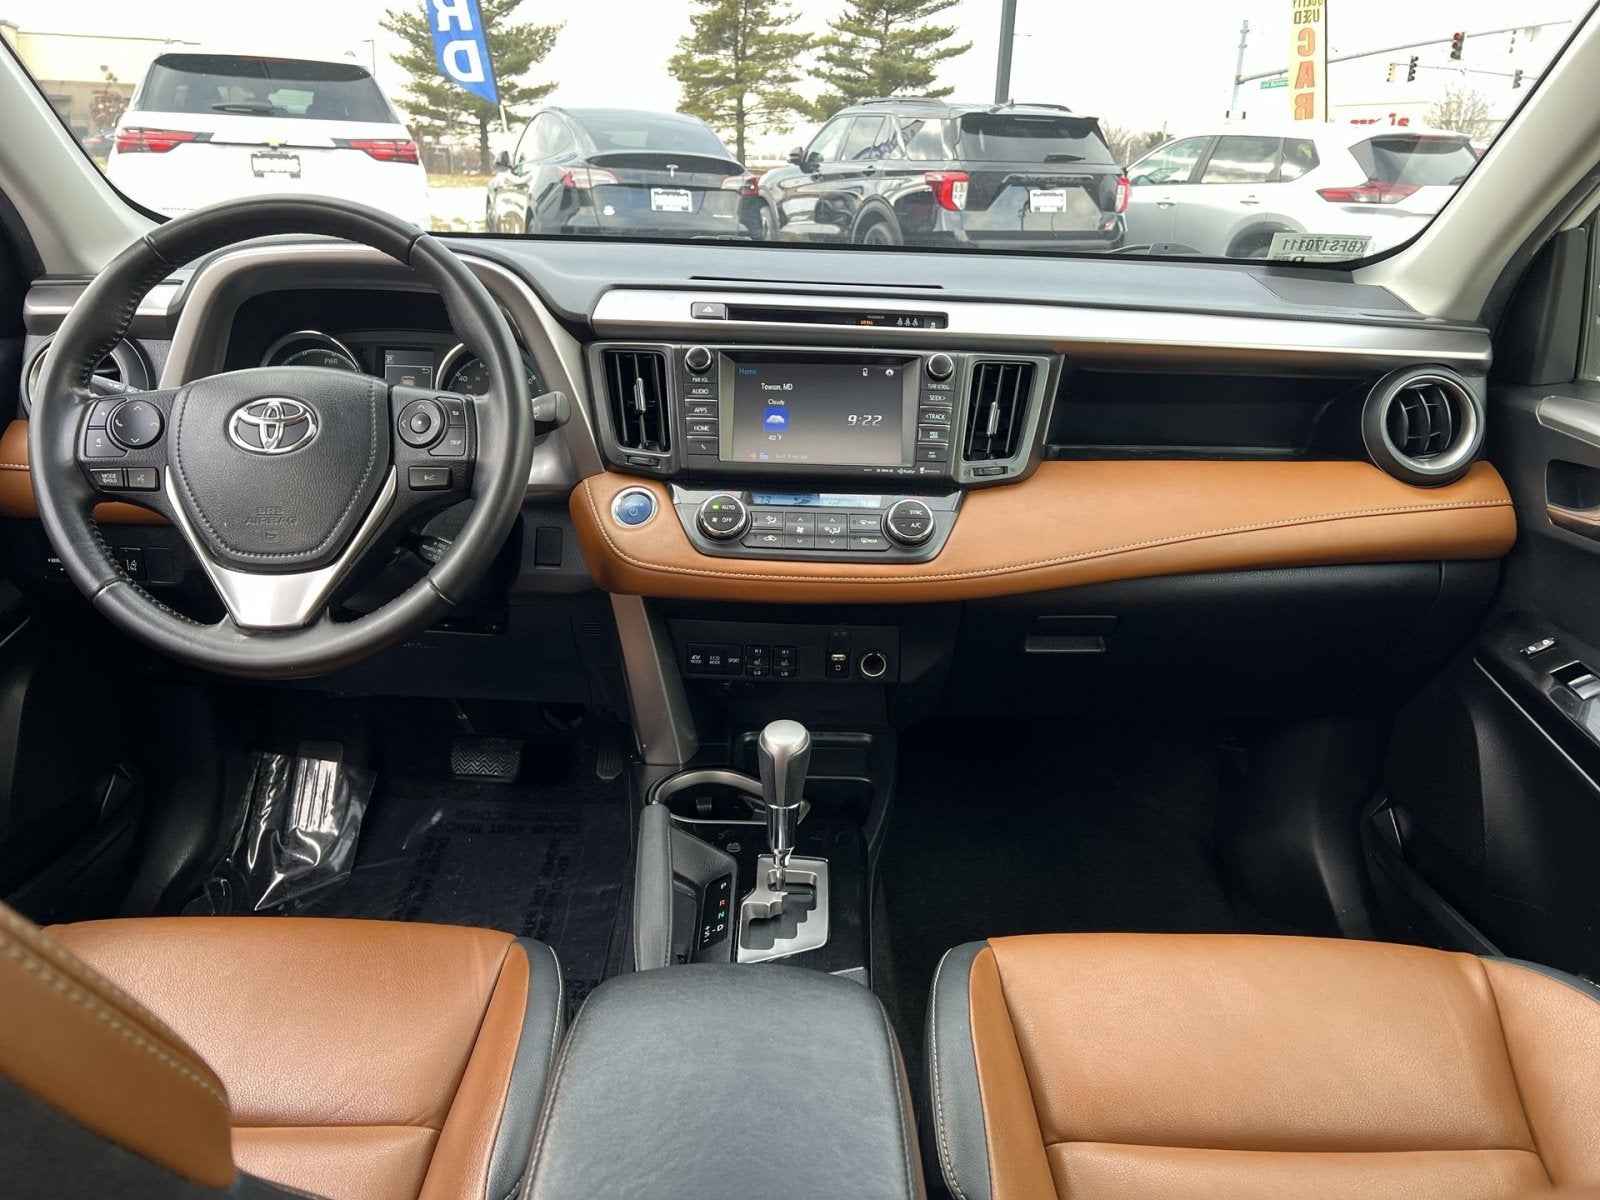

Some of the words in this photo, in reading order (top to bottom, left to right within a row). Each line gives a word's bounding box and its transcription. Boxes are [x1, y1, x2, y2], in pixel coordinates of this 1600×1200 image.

[324, 357, 338, 365] PWR
[738, 367, 758, 375] Home
[783, 383, 793, 391] MD
[847, 414, 883, 427] 9:22
[717, 911, 725, 919] N
